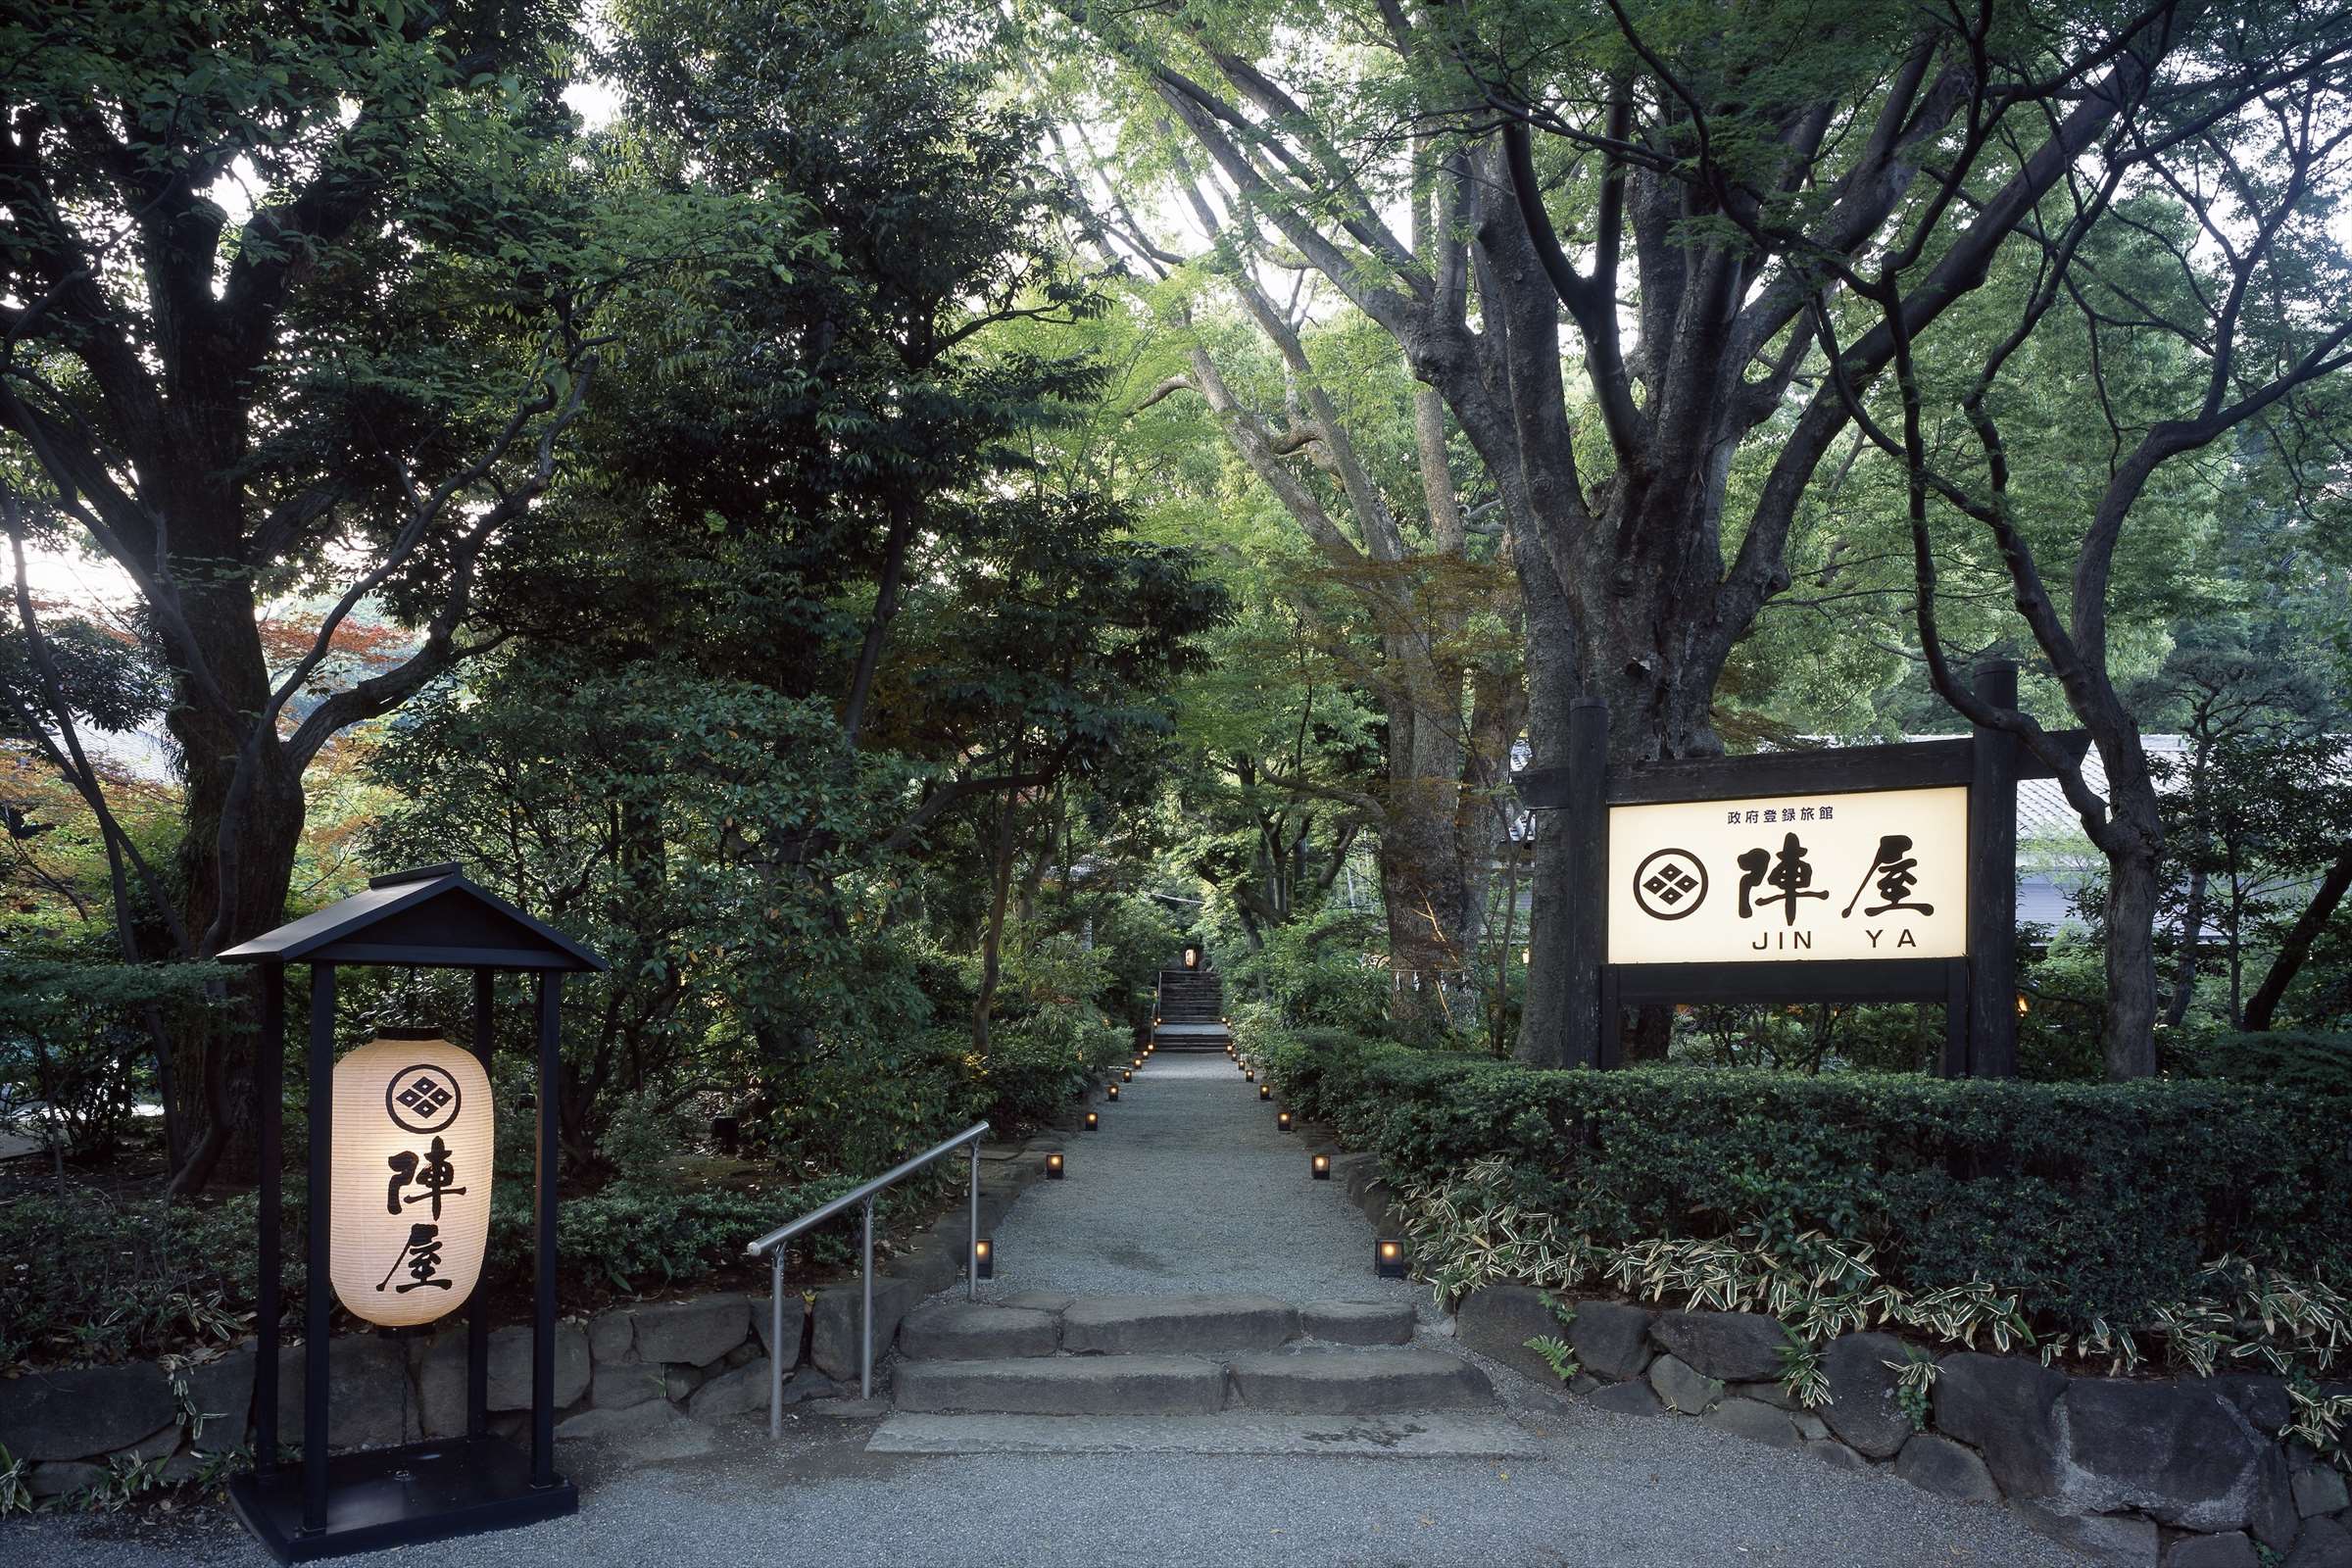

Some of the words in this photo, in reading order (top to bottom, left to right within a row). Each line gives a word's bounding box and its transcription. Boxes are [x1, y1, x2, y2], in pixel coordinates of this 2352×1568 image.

[1728, 807, 1834, 824] 政府登録旅館
[1737, 832, 1935, 927] 陣屋
[1752, 931, 1812, 950] JIN
[1865, 929, 1917, 948] YA
[376, 1135, 466, 1295] 陣屋
